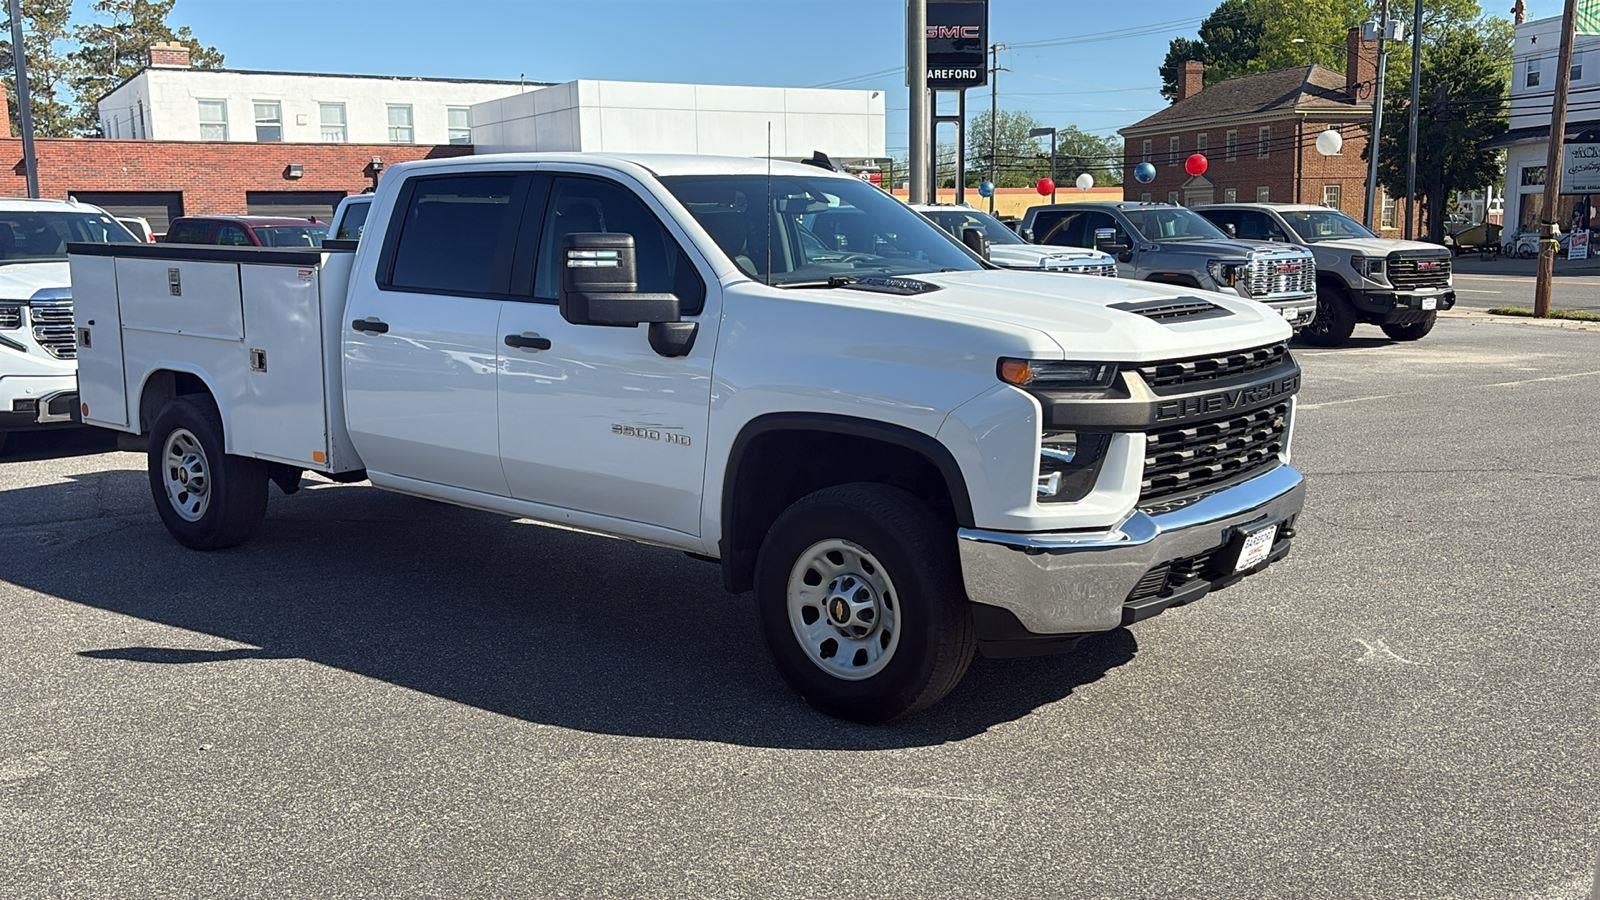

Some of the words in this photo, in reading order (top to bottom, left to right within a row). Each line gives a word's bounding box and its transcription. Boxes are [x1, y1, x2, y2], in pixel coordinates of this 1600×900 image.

[925, 25, 980, 39] GMC
[927, 69, 977, 79] AREFORD
[1156, 376, 1299, 421] CHEVROLET
[610, 423, 660, 441] 3500
[665, 432, 692, 446] HD
